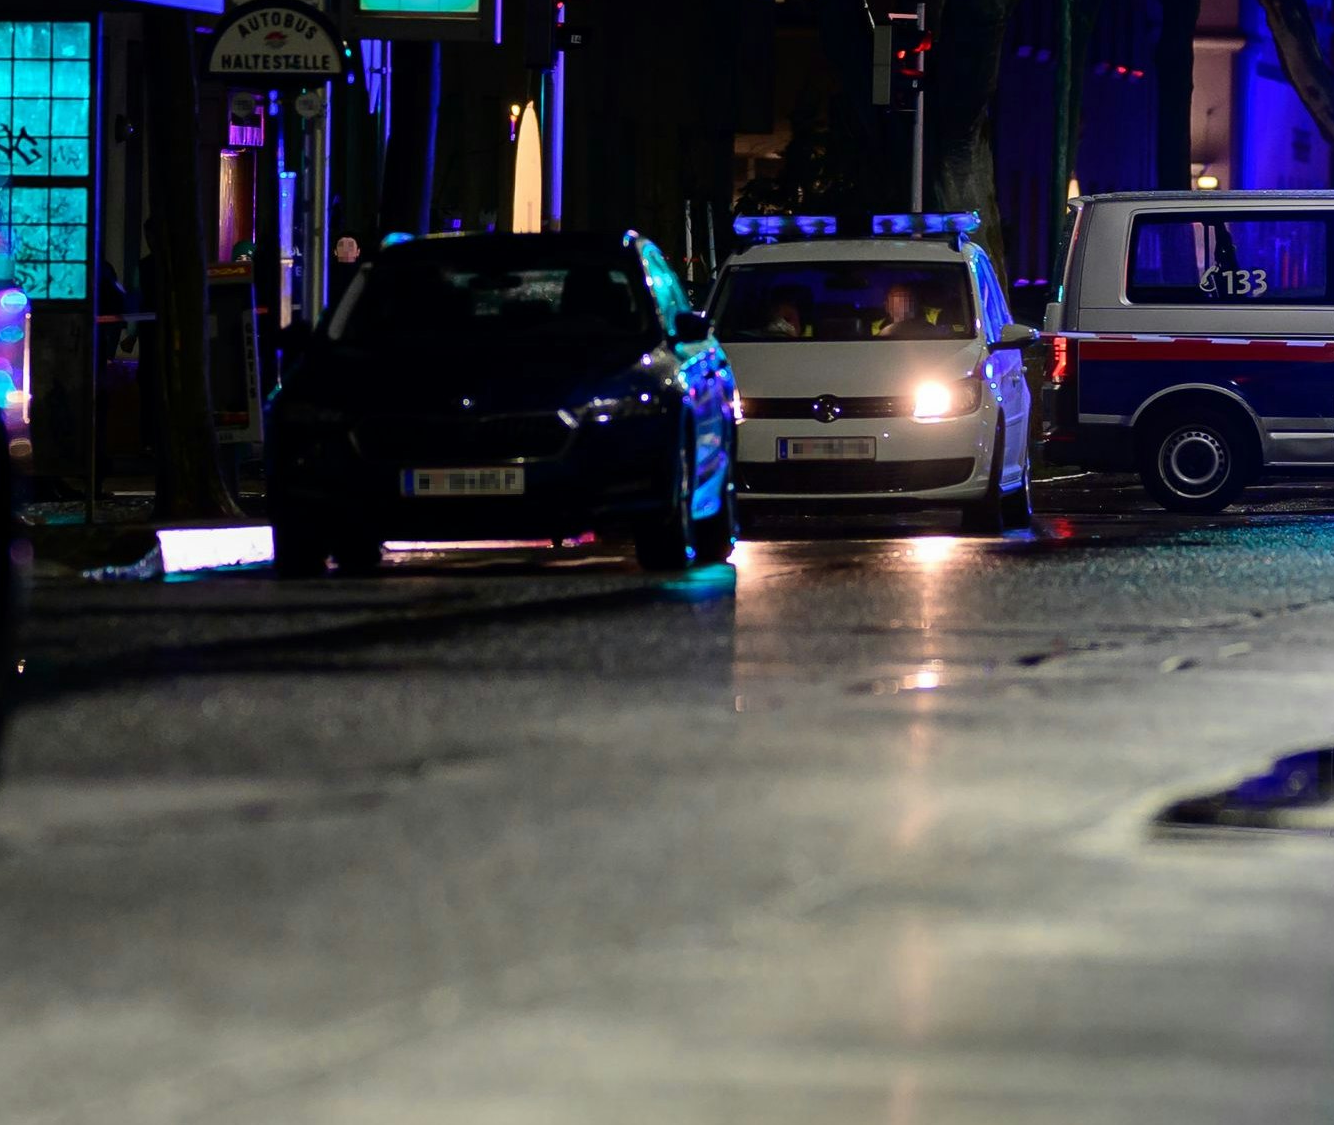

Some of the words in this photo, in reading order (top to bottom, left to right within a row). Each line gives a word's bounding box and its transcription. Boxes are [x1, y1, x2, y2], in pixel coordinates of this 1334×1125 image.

[238, 12, 317, 39] AUTOBUS
[221, 54, 330, 70] HALTESTELLE
[1222, 270, 1268, 296] 133
